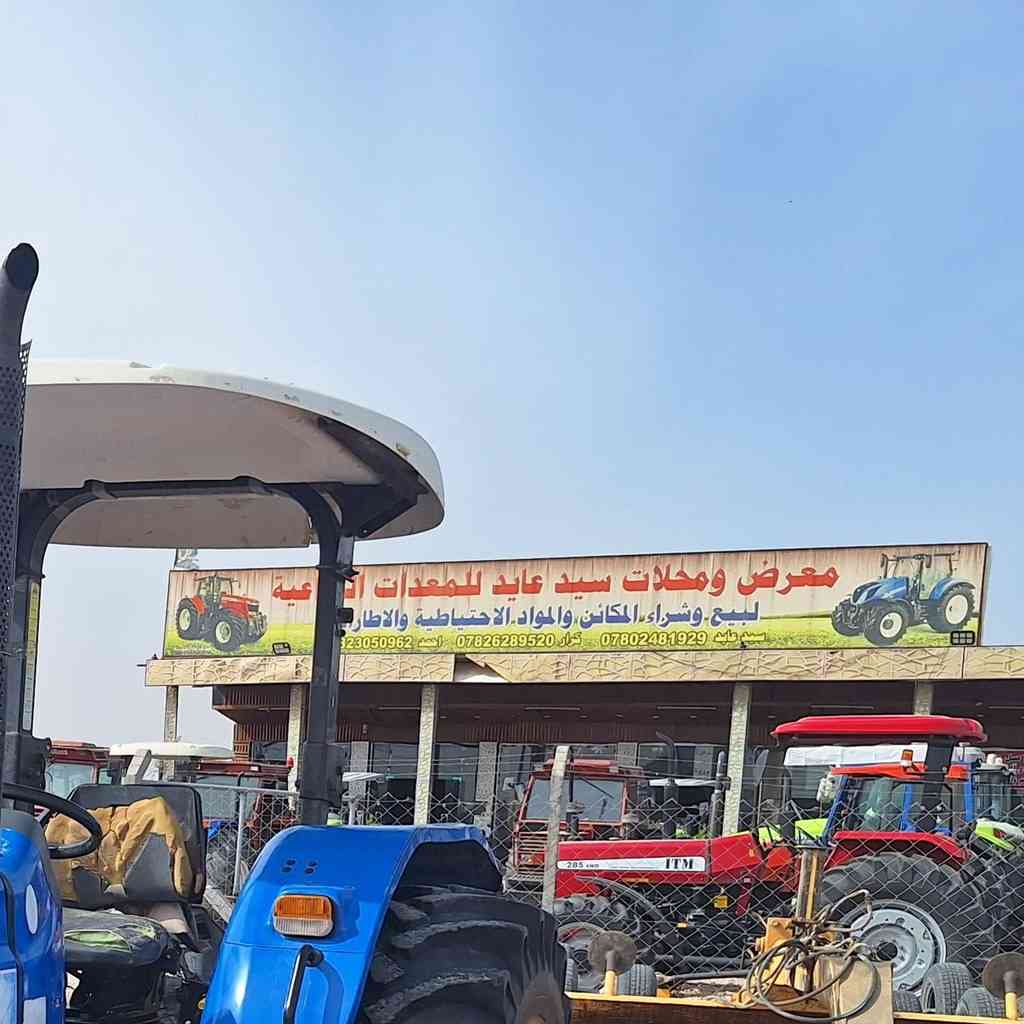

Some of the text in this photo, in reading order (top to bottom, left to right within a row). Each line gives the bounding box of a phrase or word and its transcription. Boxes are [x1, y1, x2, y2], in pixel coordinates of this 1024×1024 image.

[375, 568, 481, 598] للمعدات
[555, 571, 610, 600] سيد
[622, 564, 726, 597] ومحلات
[737, 560, 839, 595] معرض
[415, 606, 510, 631] الاحتياطية
[517, 605, 573, 630] والمواد
[647, 602, 703, 628] وشراء
[711, 601, 759, 627] لبيع
[456, 633, 554, 649] 07826289520
[601, 631, 707, 647] 07802481929
[566, 861, 584, 869] 285
[665, 858, 694, 869] ITM
